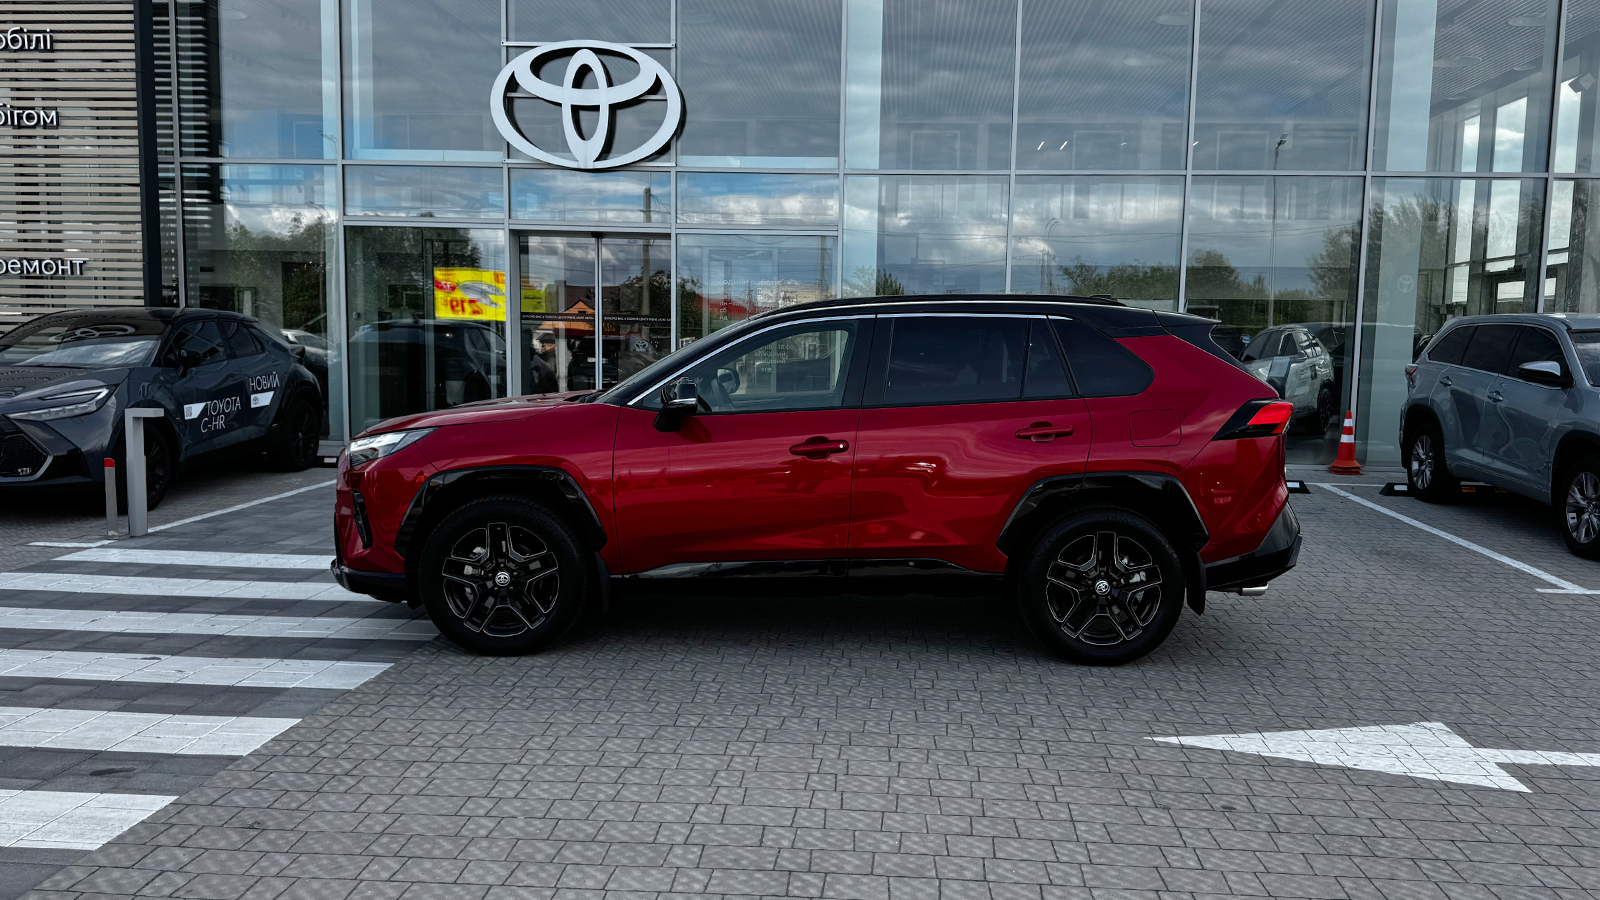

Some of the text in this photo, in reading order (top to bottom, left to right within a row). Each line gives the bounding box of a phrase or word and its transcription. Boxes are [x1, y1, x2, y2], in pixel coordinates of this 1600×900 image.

[250, 371, 280, 391] НОВИЙ
[206, 396, 242, 416] TOYOTA
[201, 414, 226, 433] C-HR
